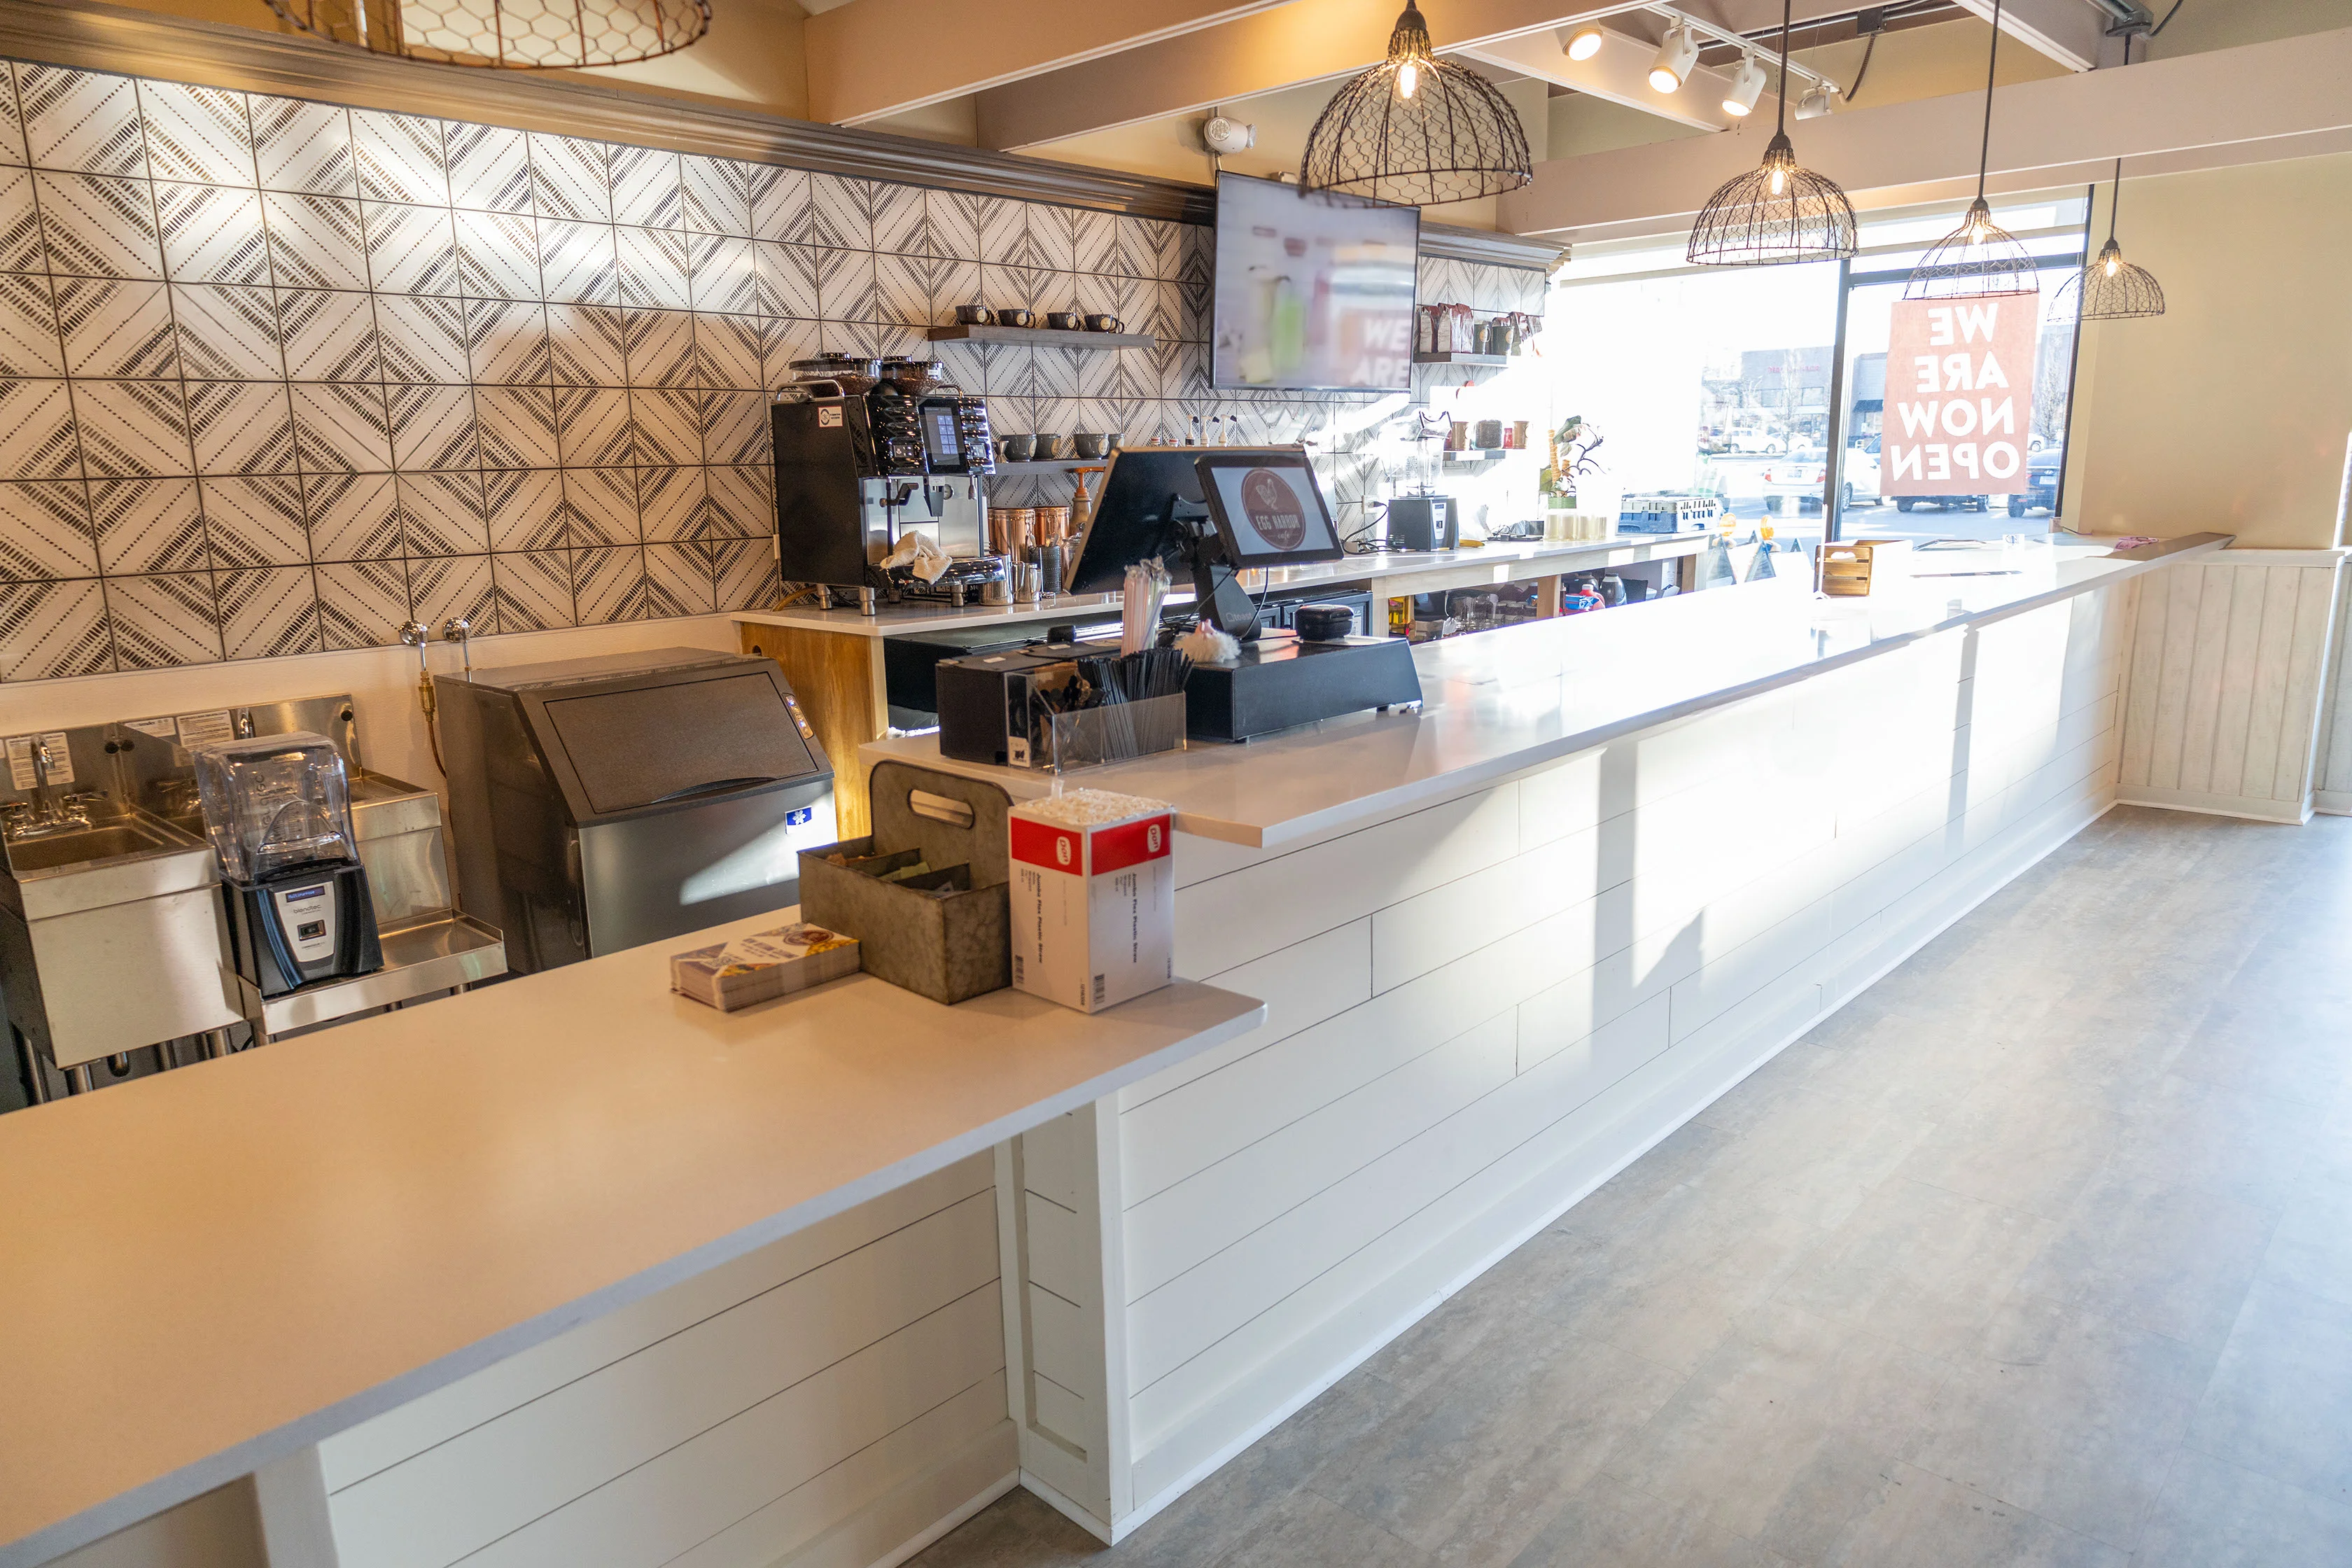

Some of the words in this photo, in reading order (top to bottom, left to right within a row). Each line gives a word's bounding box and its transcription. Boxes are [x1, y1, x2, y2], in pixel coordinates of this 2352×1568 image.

[1364, 318, 1410, 349] WE
[1350, 356, 1409, 386] ARE
[1256, 515, 1271, 531] EGG
[1272, 514, 1301, 529] HARBOR
[293, 904, 322, 914] blendtec
